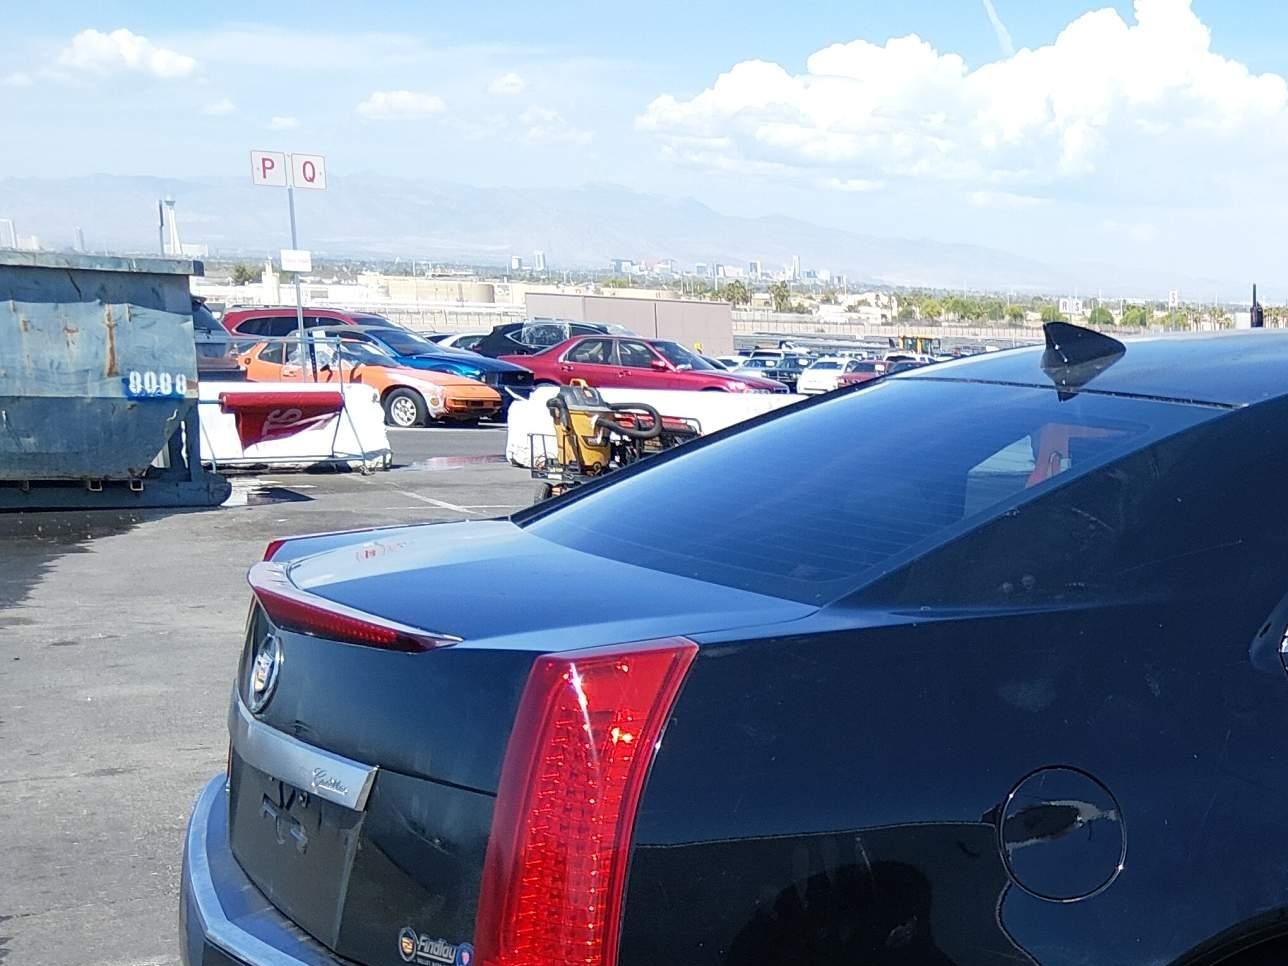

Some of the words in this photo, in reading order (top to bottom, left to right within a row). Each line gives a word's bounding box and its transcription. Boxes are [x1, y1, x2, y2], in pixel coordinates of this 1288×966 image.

[261, 157, 275, 179] P
[302, 160, 316, 183] Q
[417, 934, 456, 962] Findlay
